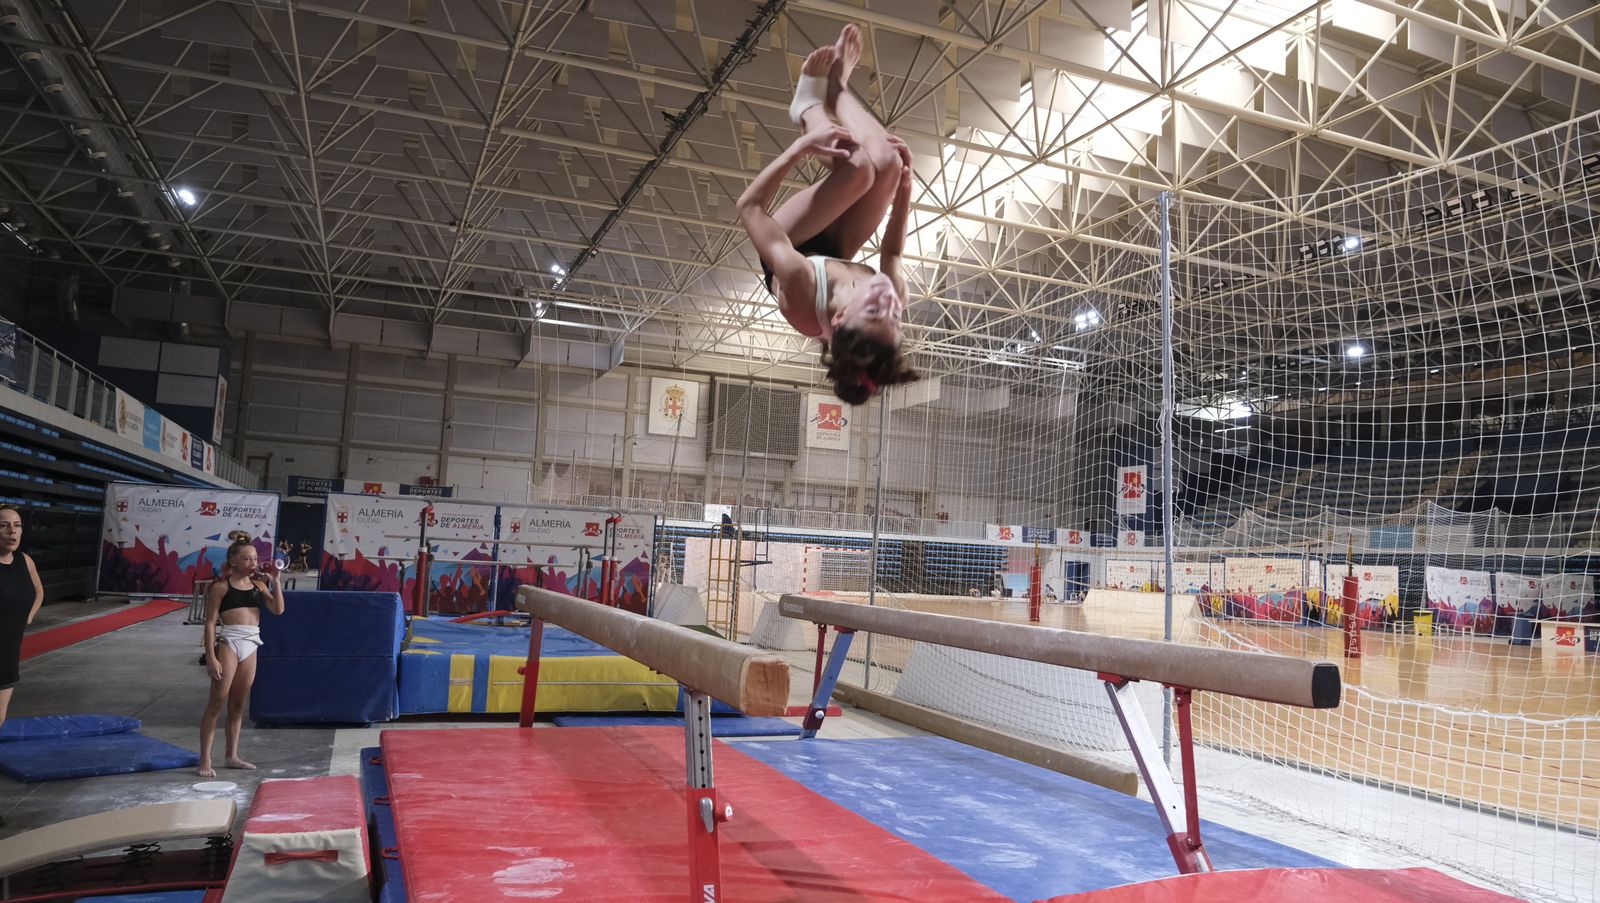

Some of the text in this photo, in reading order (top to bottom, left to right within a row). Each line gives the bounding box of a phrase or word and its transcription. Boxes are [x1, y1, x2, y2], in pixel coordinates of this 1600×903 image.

[137, 497, 185, 508] ALMERÍA
[222, 506, 263, 514] DEPORTES
[358, 507, 404, 518] ALMERÍA
[440, 516, 480, 525] DEPORTES
[529, 517, 572, 529] ALMERÍA
